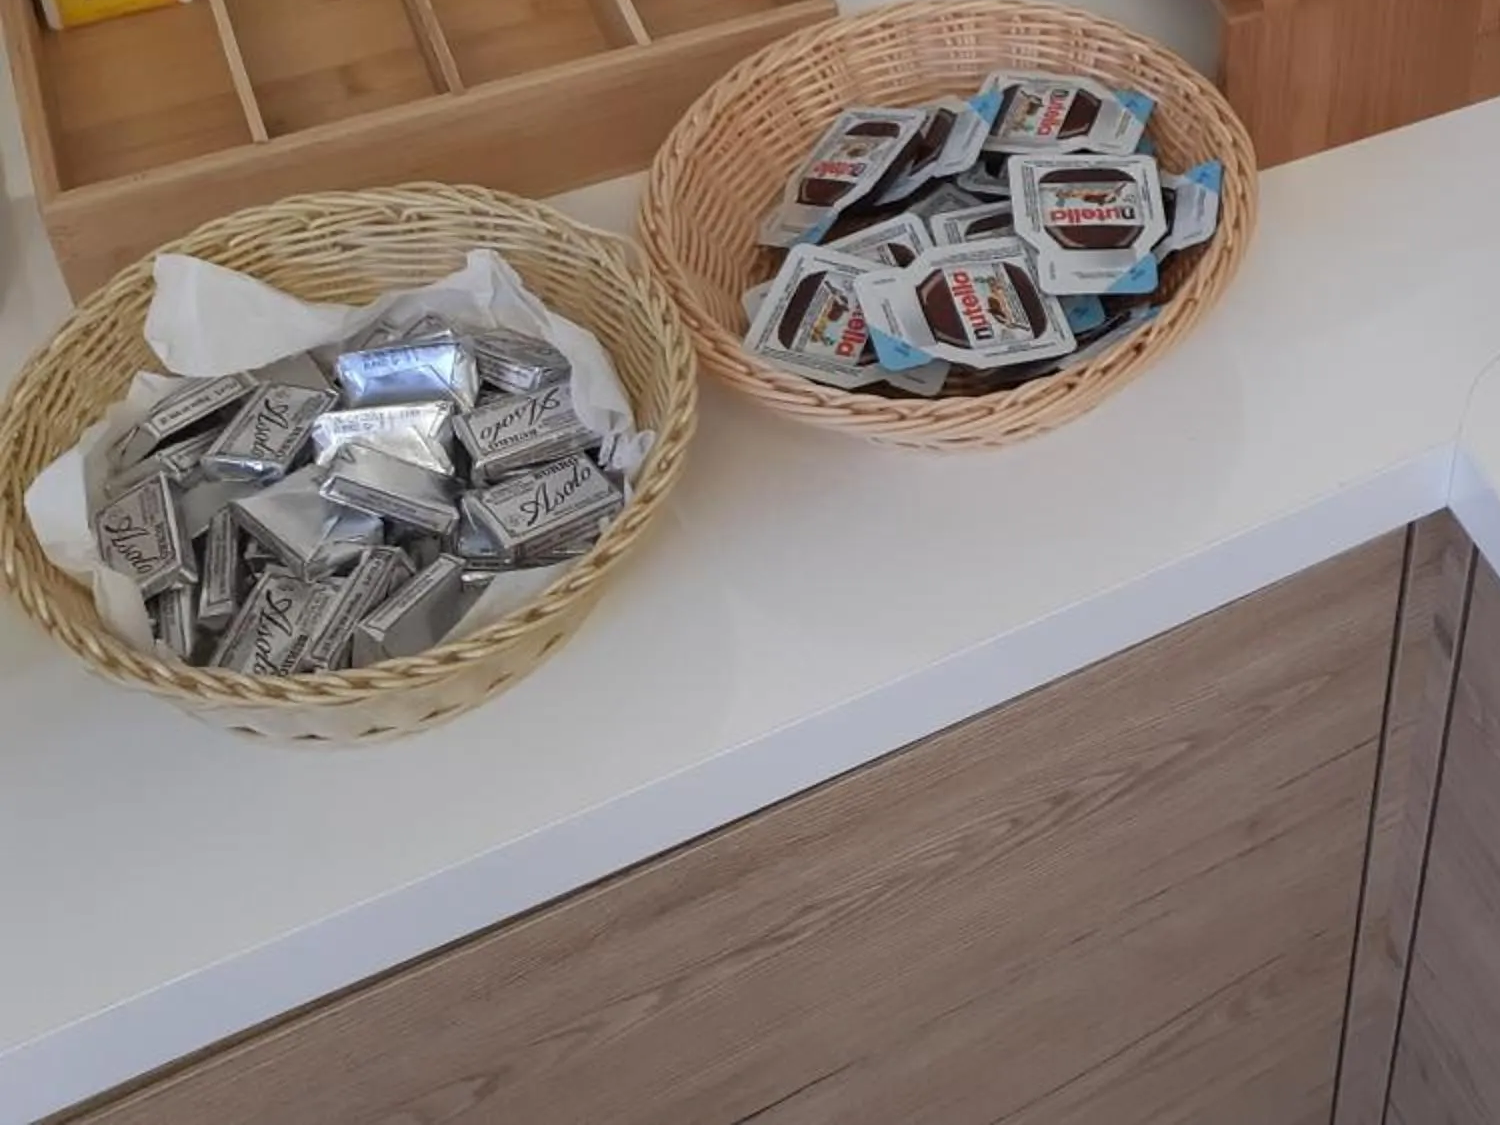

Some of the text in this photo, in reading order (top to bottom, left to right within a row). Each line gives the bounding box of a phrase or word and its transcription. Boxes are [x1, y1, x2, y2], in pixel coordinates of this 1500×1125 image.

[1050, 206, 1136, 224] nutella
[951, 267, 994, 340] nutella
[480, 386, 560, 442] Asolo
[519, 466, 592, 527] Asolo
[104, 515, 159, 575] Asolo
